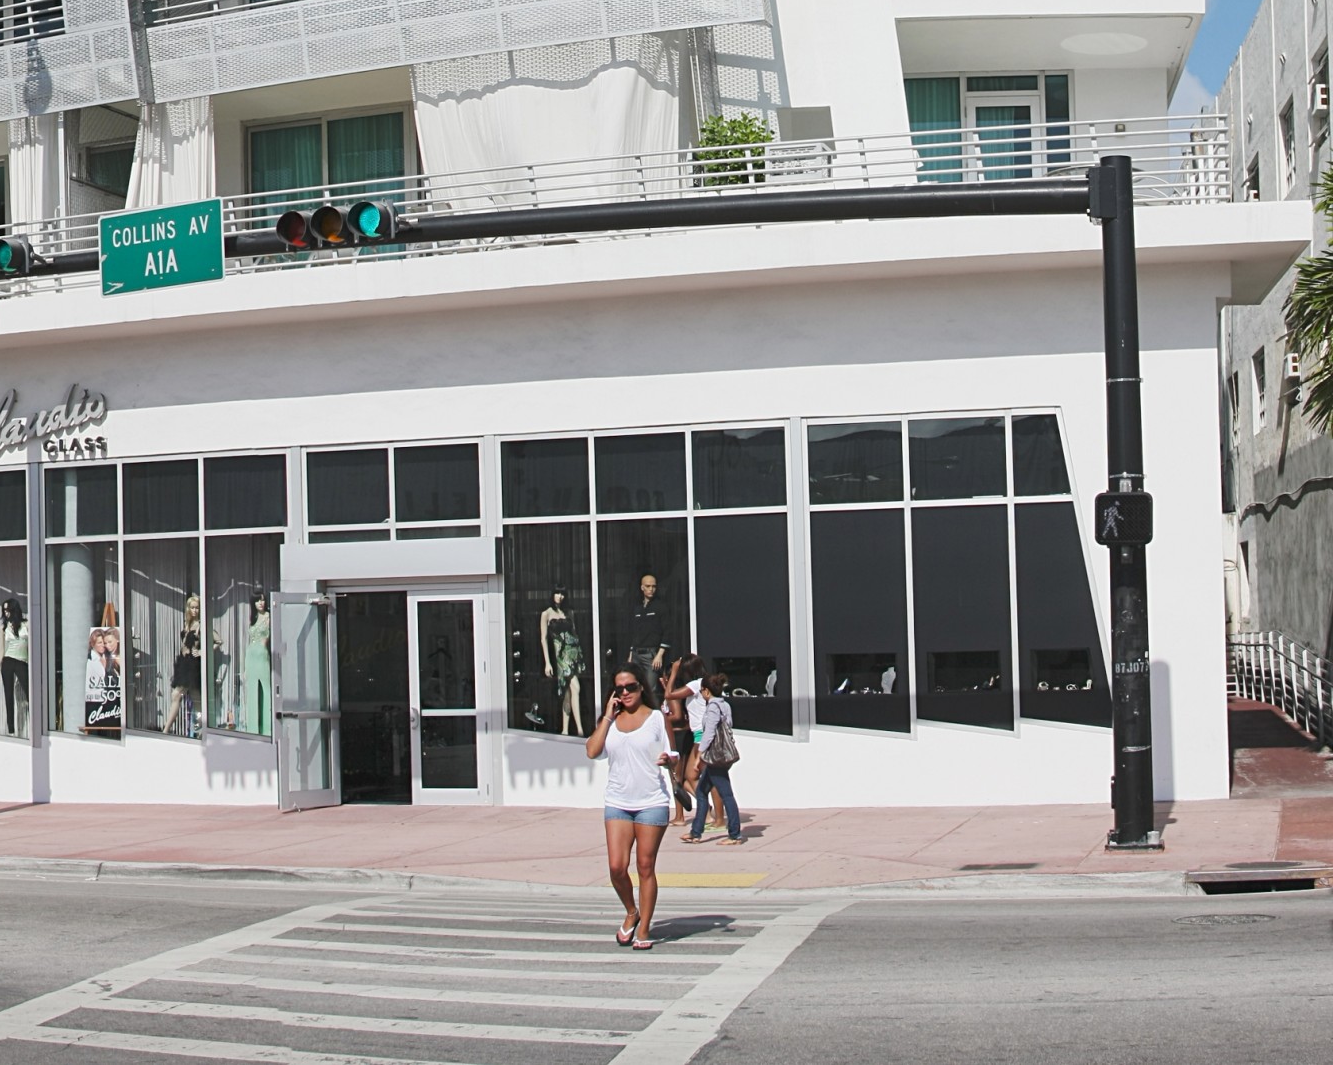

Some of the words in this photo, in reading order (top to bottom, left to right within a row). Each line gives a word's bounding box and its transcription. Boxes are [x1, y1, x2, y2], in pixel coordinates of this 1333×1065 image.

[113, 220, 176, 247] COLLINS
[189, 215, 209, 235] AV
[144, 249, 178, 277] A1A
